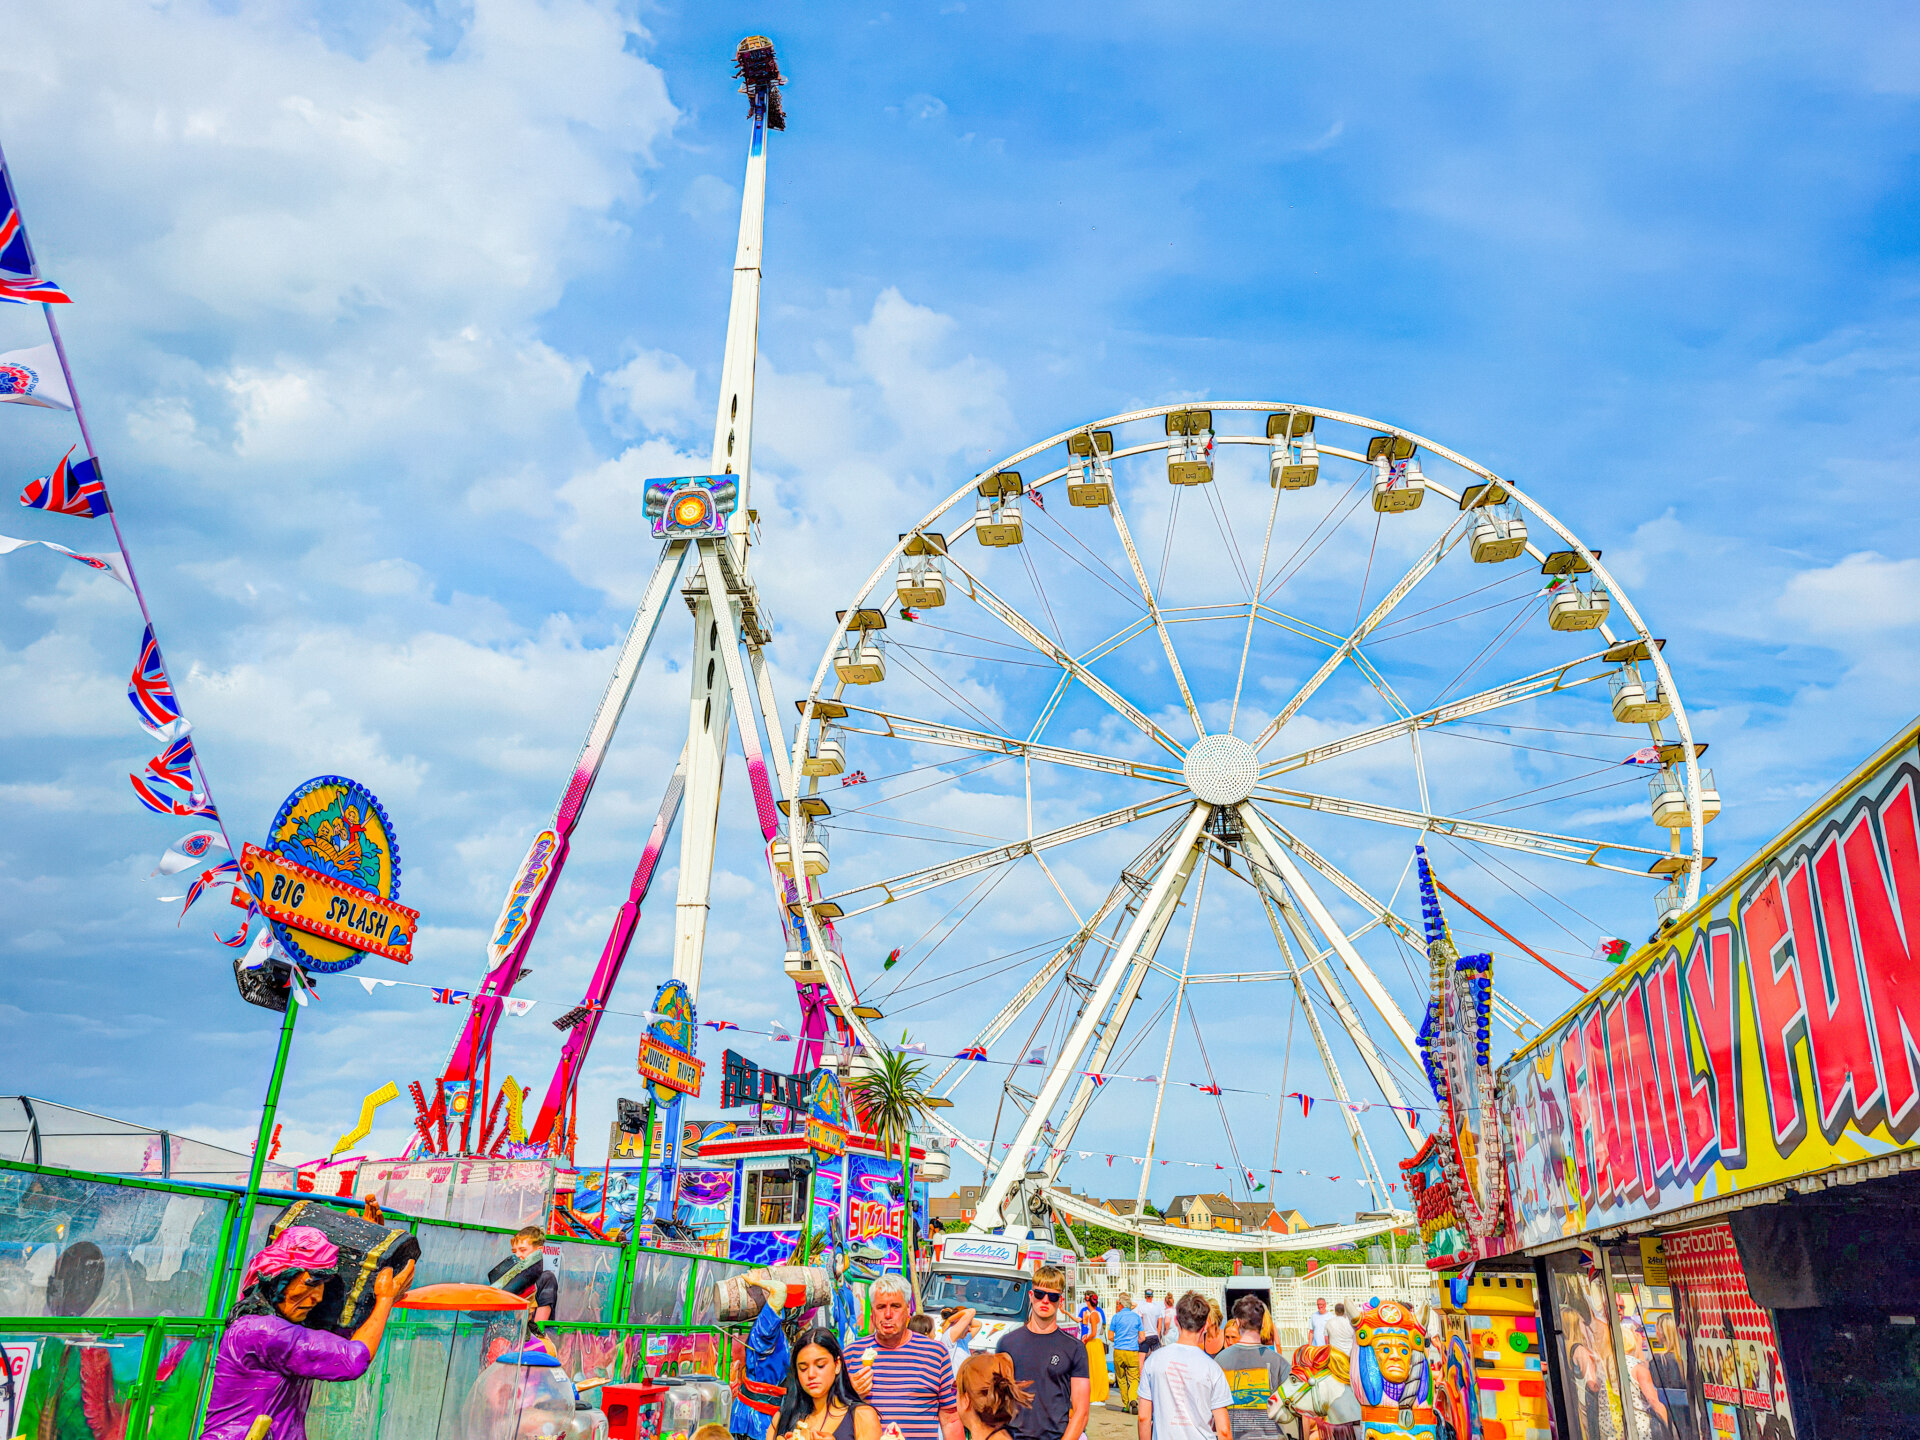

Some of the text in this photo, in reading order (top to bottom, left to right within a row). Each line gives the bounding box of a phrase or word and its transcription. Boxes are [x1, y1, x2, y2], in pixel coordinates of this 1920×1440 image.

[270, 873, 389, 940] BIG SPLASH
[1560, 773, 1920, 1201] FAMILY FUN
[645, 1047, 696, 1086] JUNGLE RIVER
[542, 1245, 561, 1256] ARNING
[1662, 1227, 1734, 1259] superbooths
